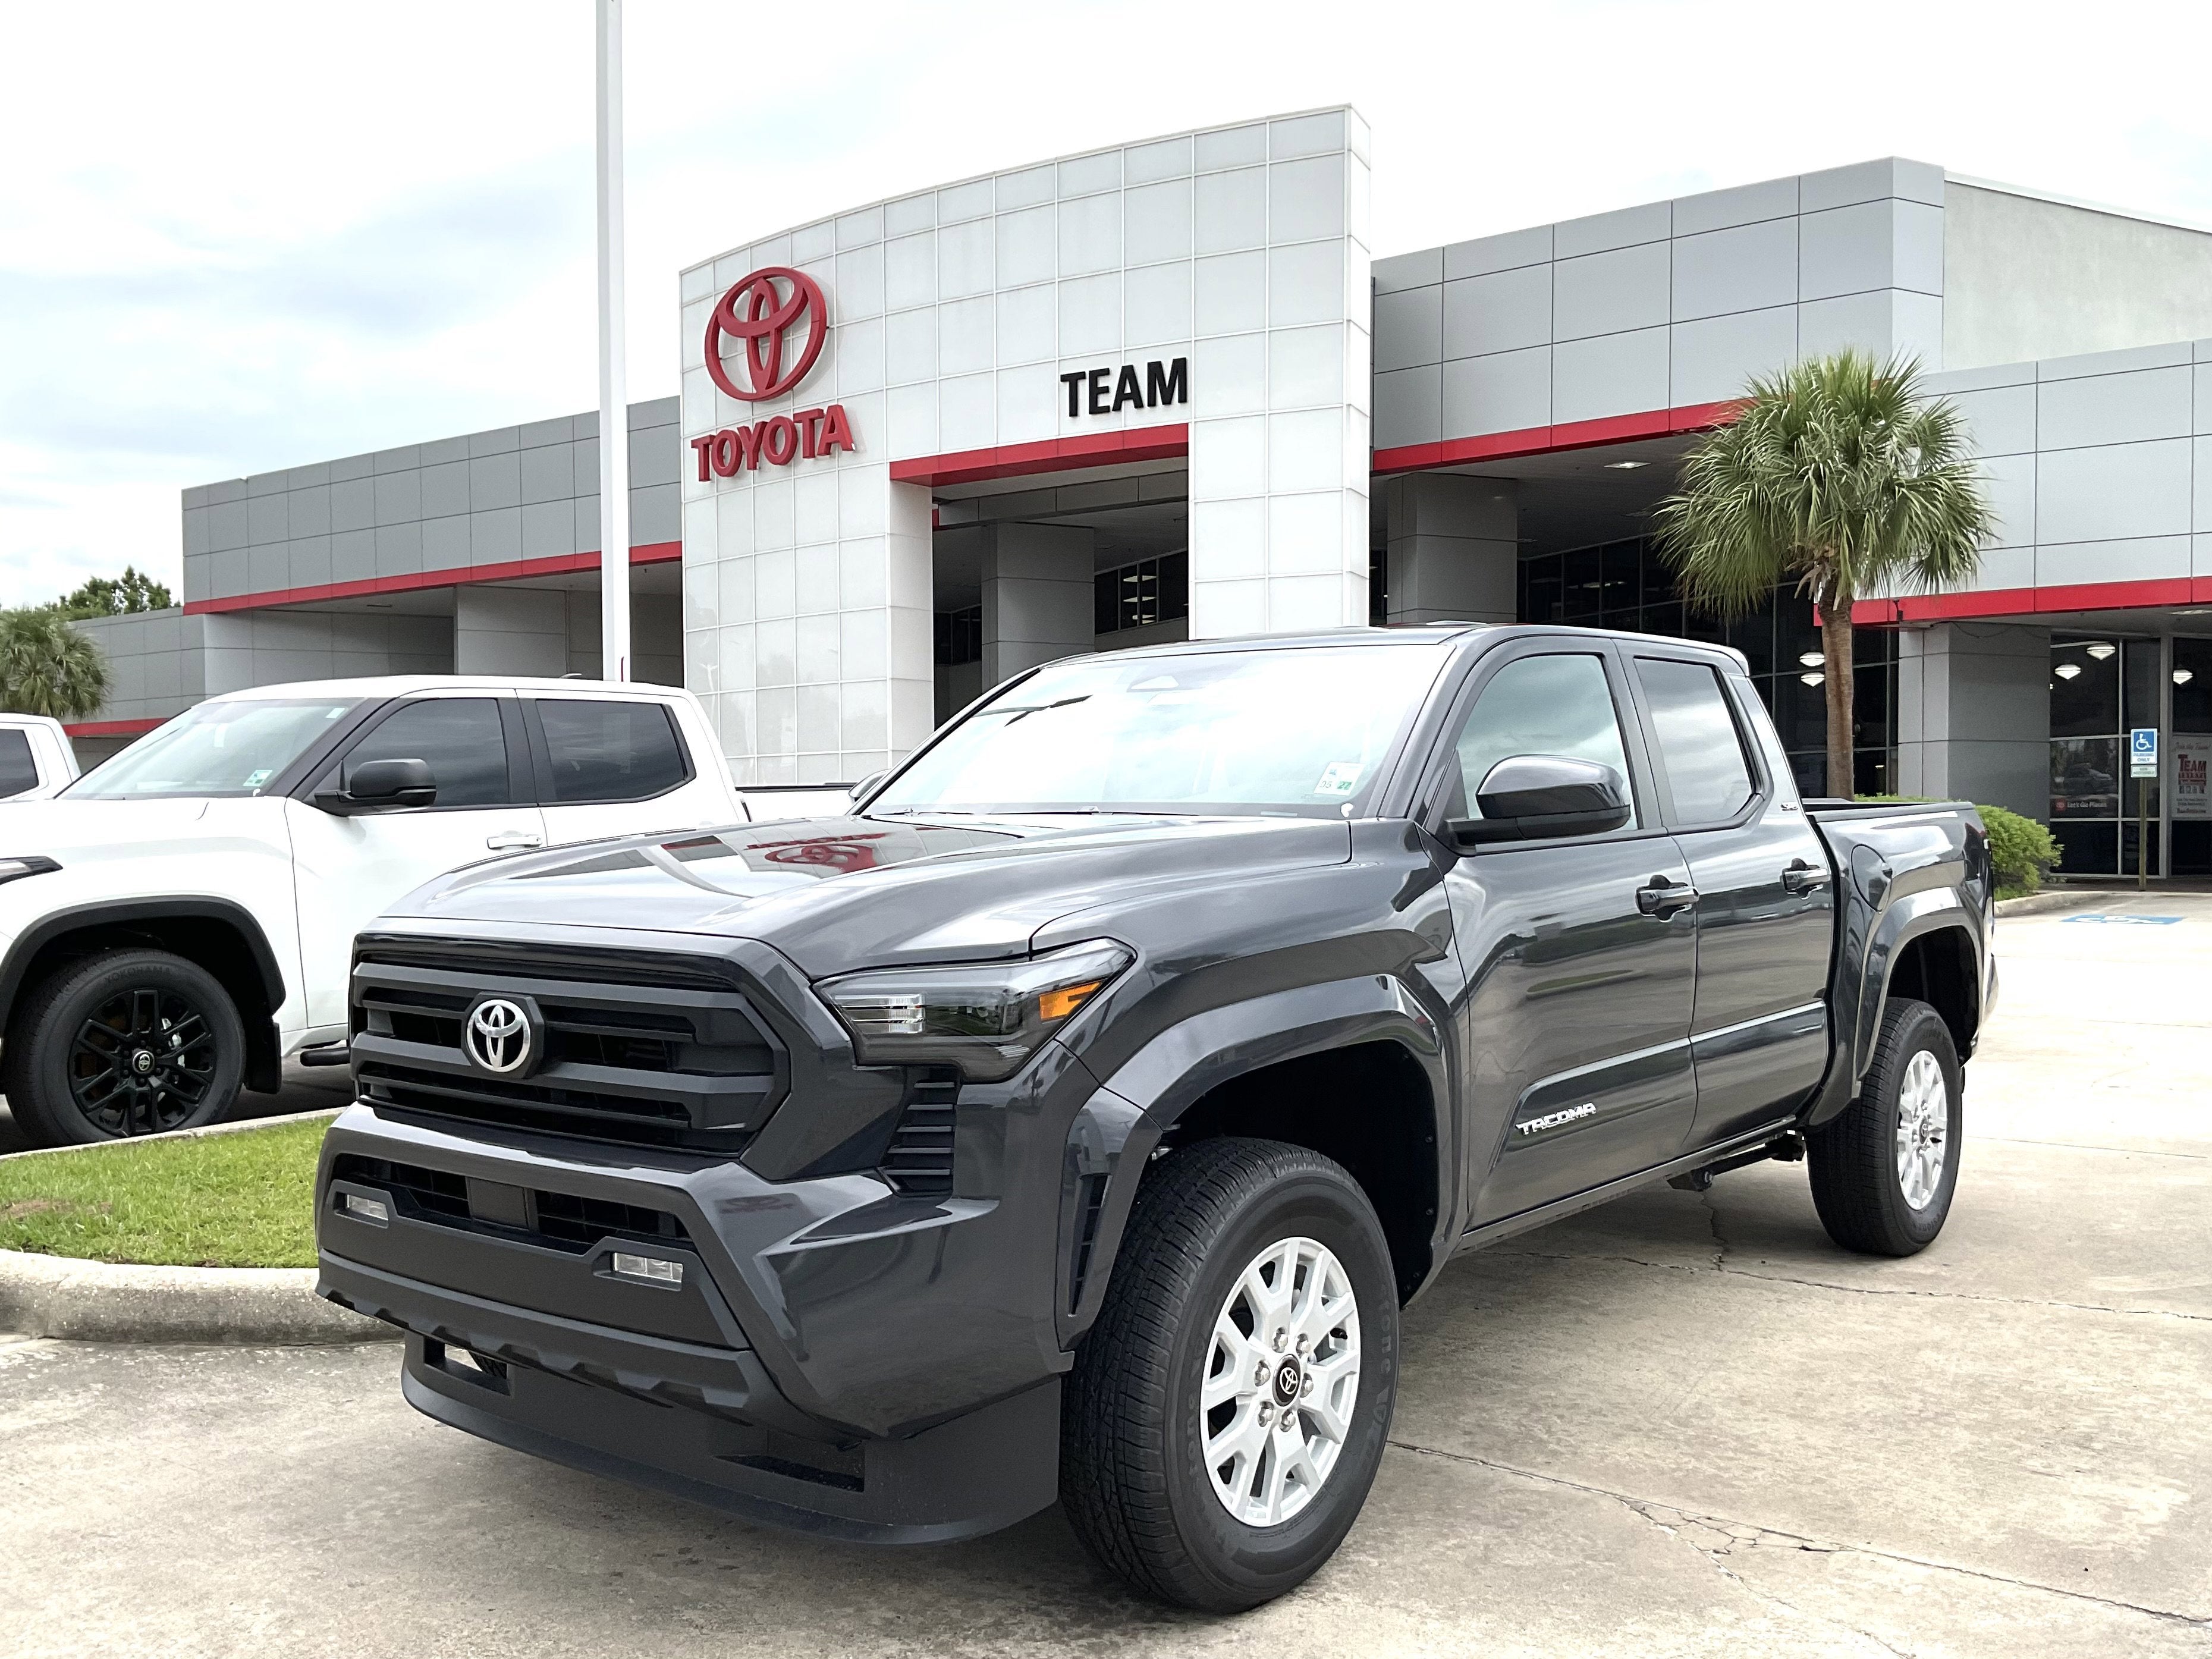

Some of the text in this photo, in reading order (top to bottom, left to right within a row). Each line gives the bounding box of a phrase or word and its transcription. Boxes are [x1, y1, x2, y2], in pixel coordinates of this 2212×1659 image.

[1060, 357, 1187, 417] TEAM
[691, 404, 856, 482] TOYOTA
[1515, 1102, 1597, 1135] TACOMA
